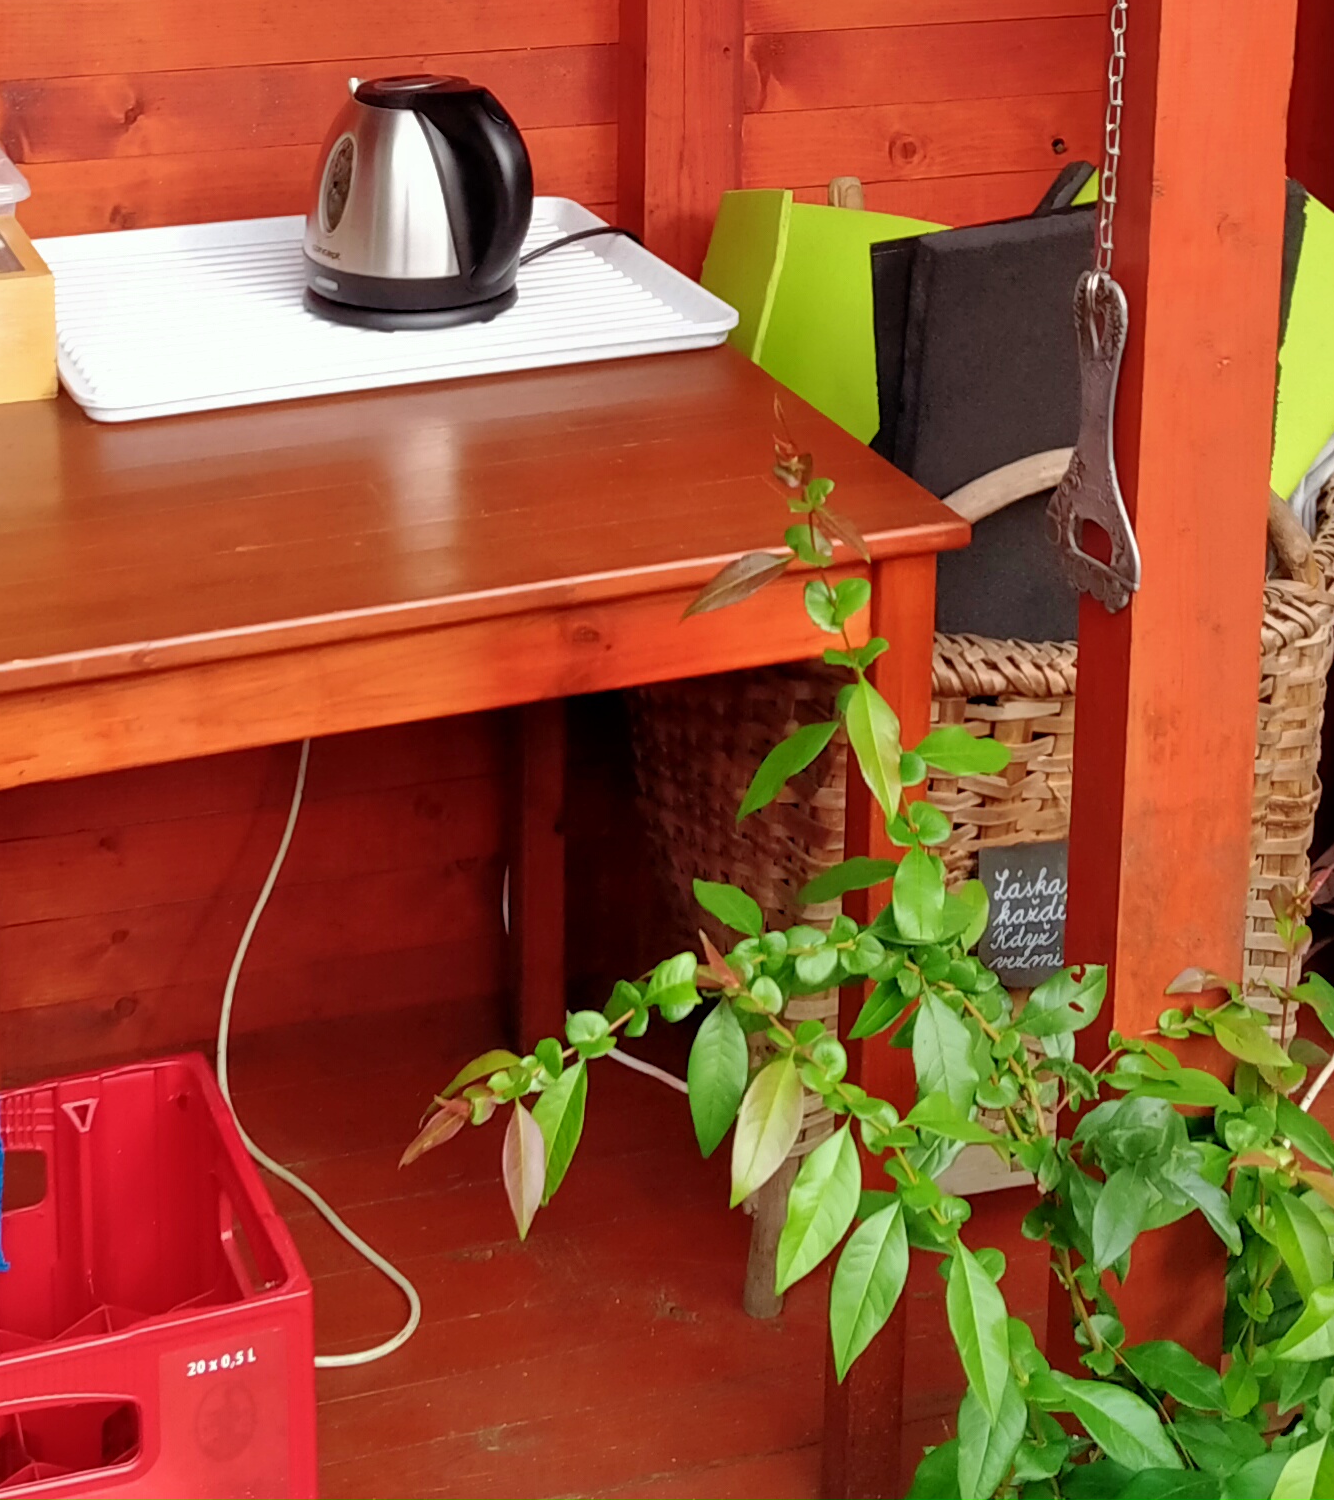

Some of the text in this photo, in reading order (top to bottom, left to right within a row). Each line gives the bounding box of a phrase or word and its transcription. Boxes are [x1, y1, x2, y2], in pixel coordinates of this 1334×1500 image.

[994, 867, 1068, 900] Láska
[990, 922, 1059, 956] Když
[988, 947, 1064, 968] vezmi
[187, 1360, 206, 1377] 20
[220, 1350, 245, 1370] 0,5
[247, 1348, 256, 1363] L
